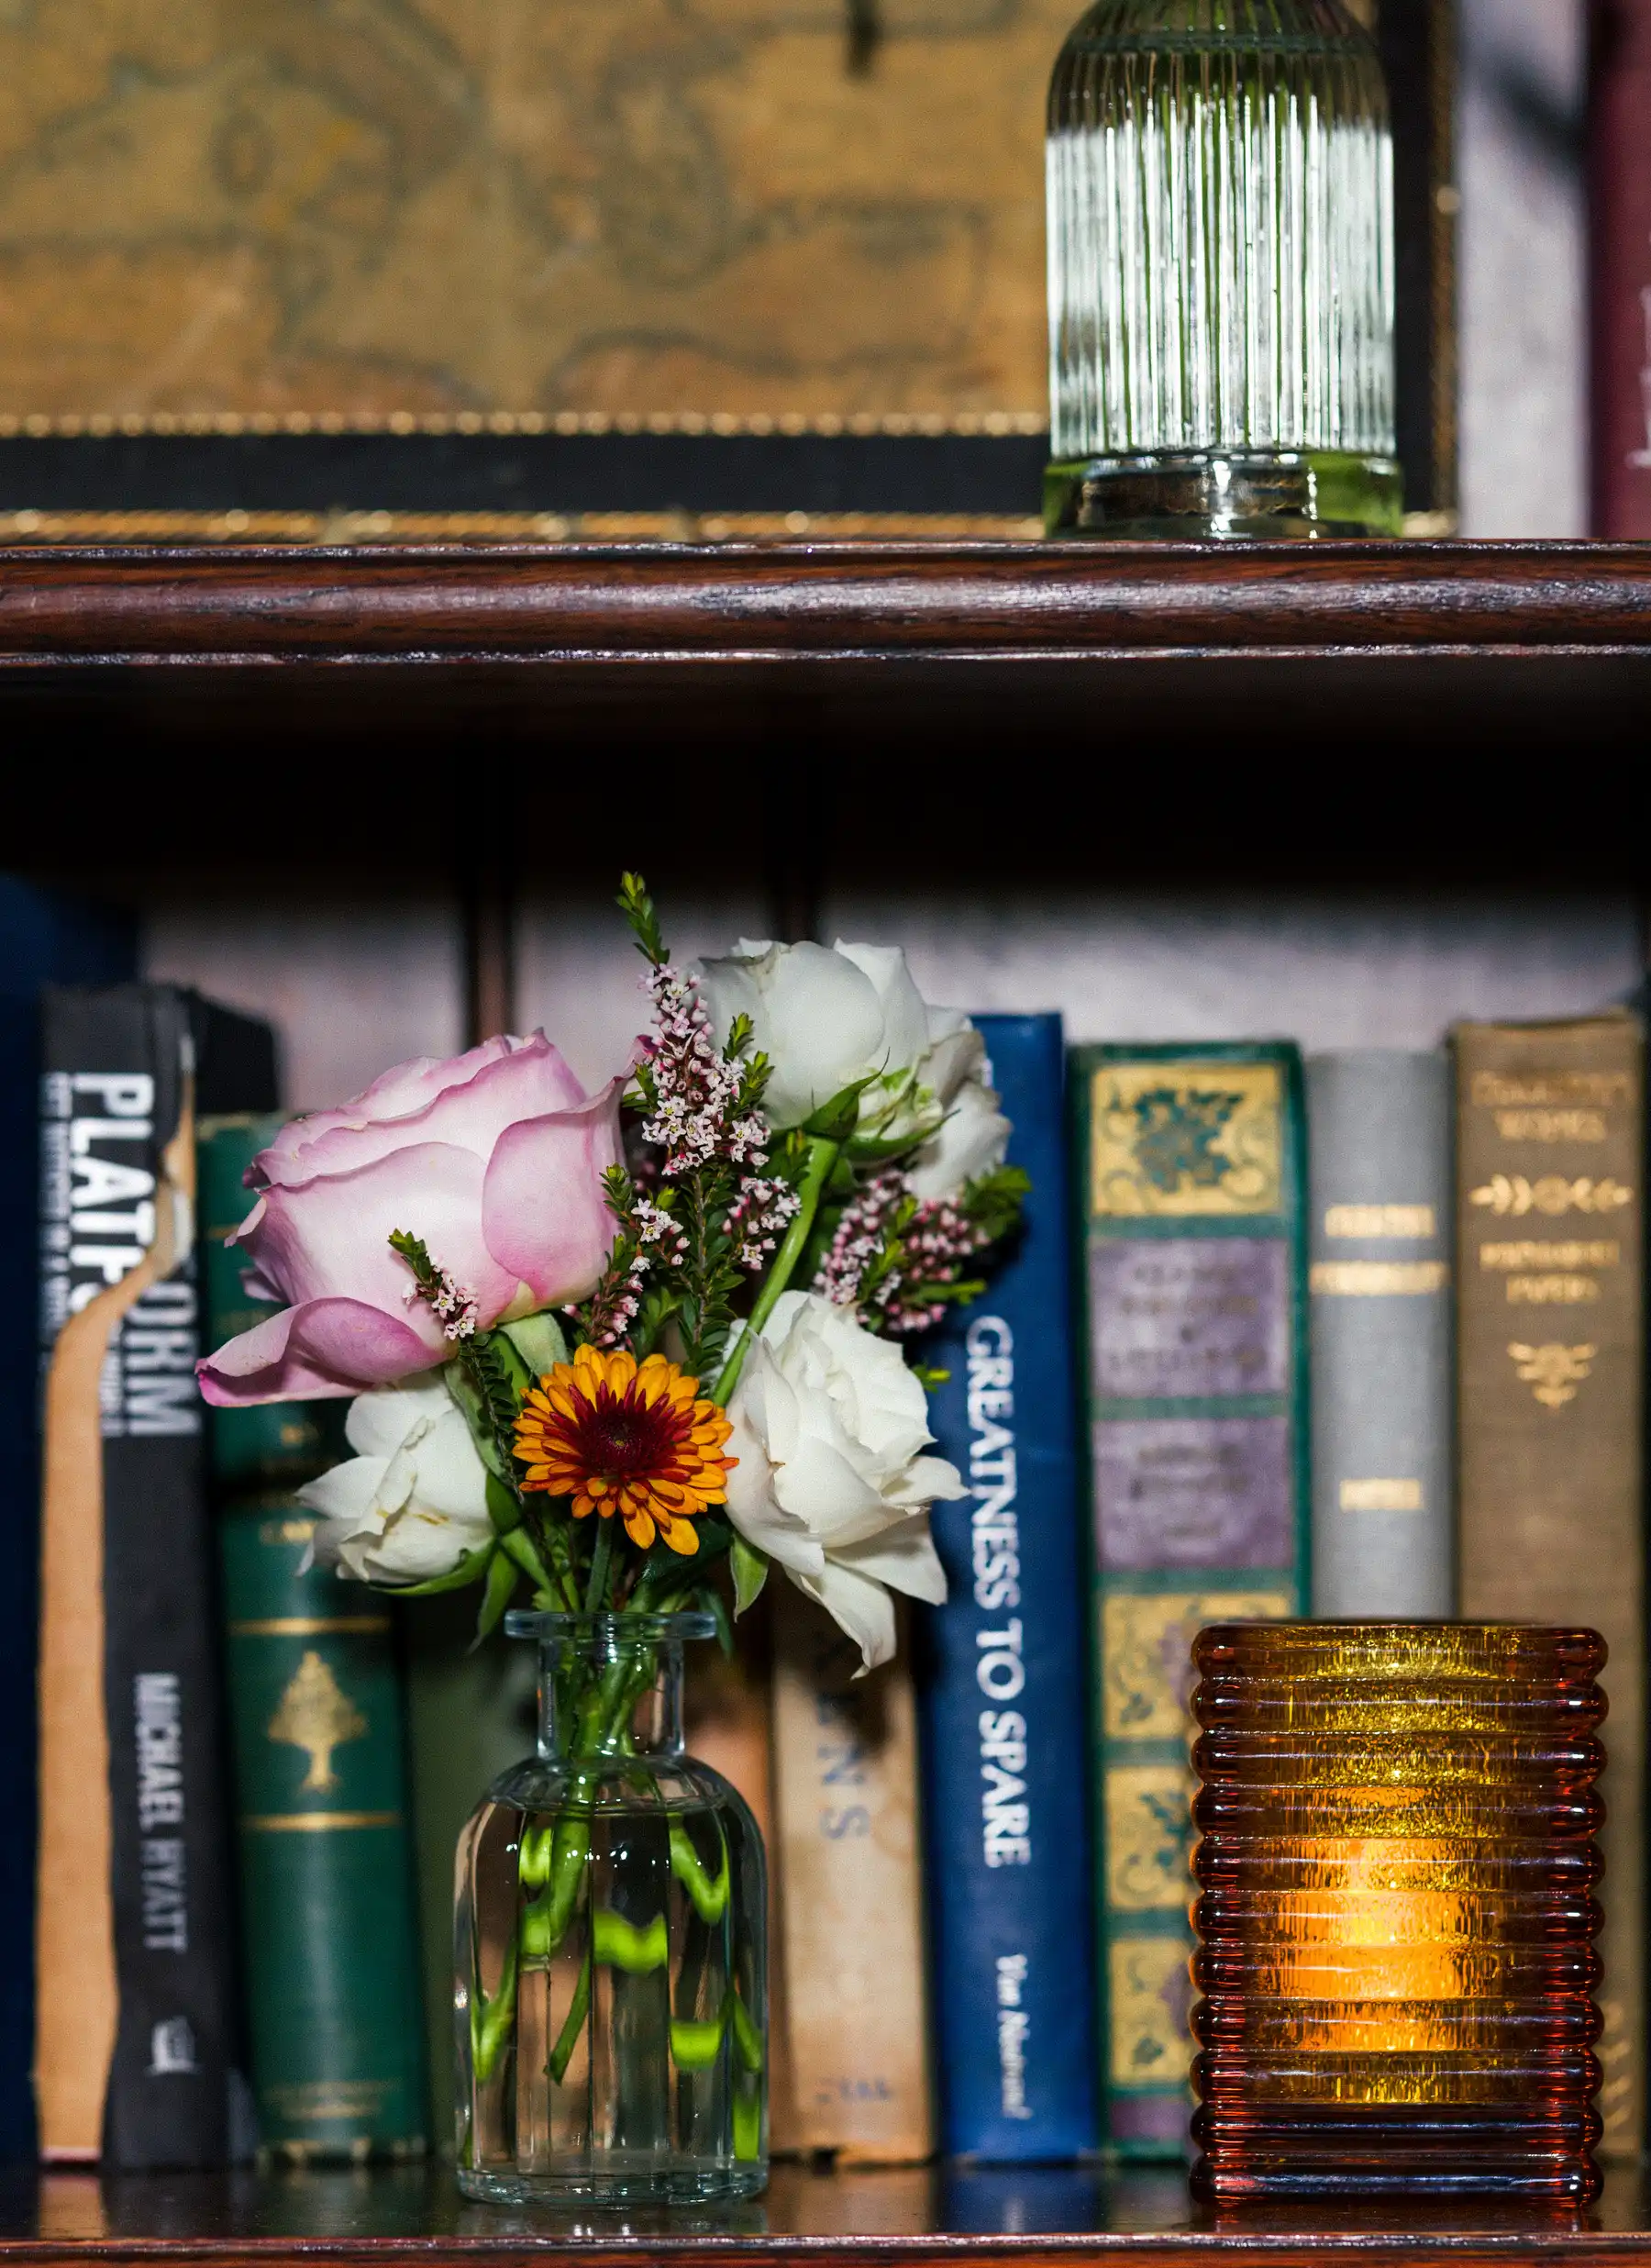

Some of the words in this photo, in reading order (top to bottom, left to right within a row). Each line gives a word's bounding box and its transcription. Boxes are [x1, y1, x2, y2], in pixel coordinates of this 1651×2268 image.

[967, 1315, 1020, 1607] GREATNESS
[976, 1618, 1025, 1698] TO
[135, 1673, 184, 1831] MICHAEL
[979, 1710, 1031, 1868] SPARE
[141, 1838, 187, 1953] HYATT
